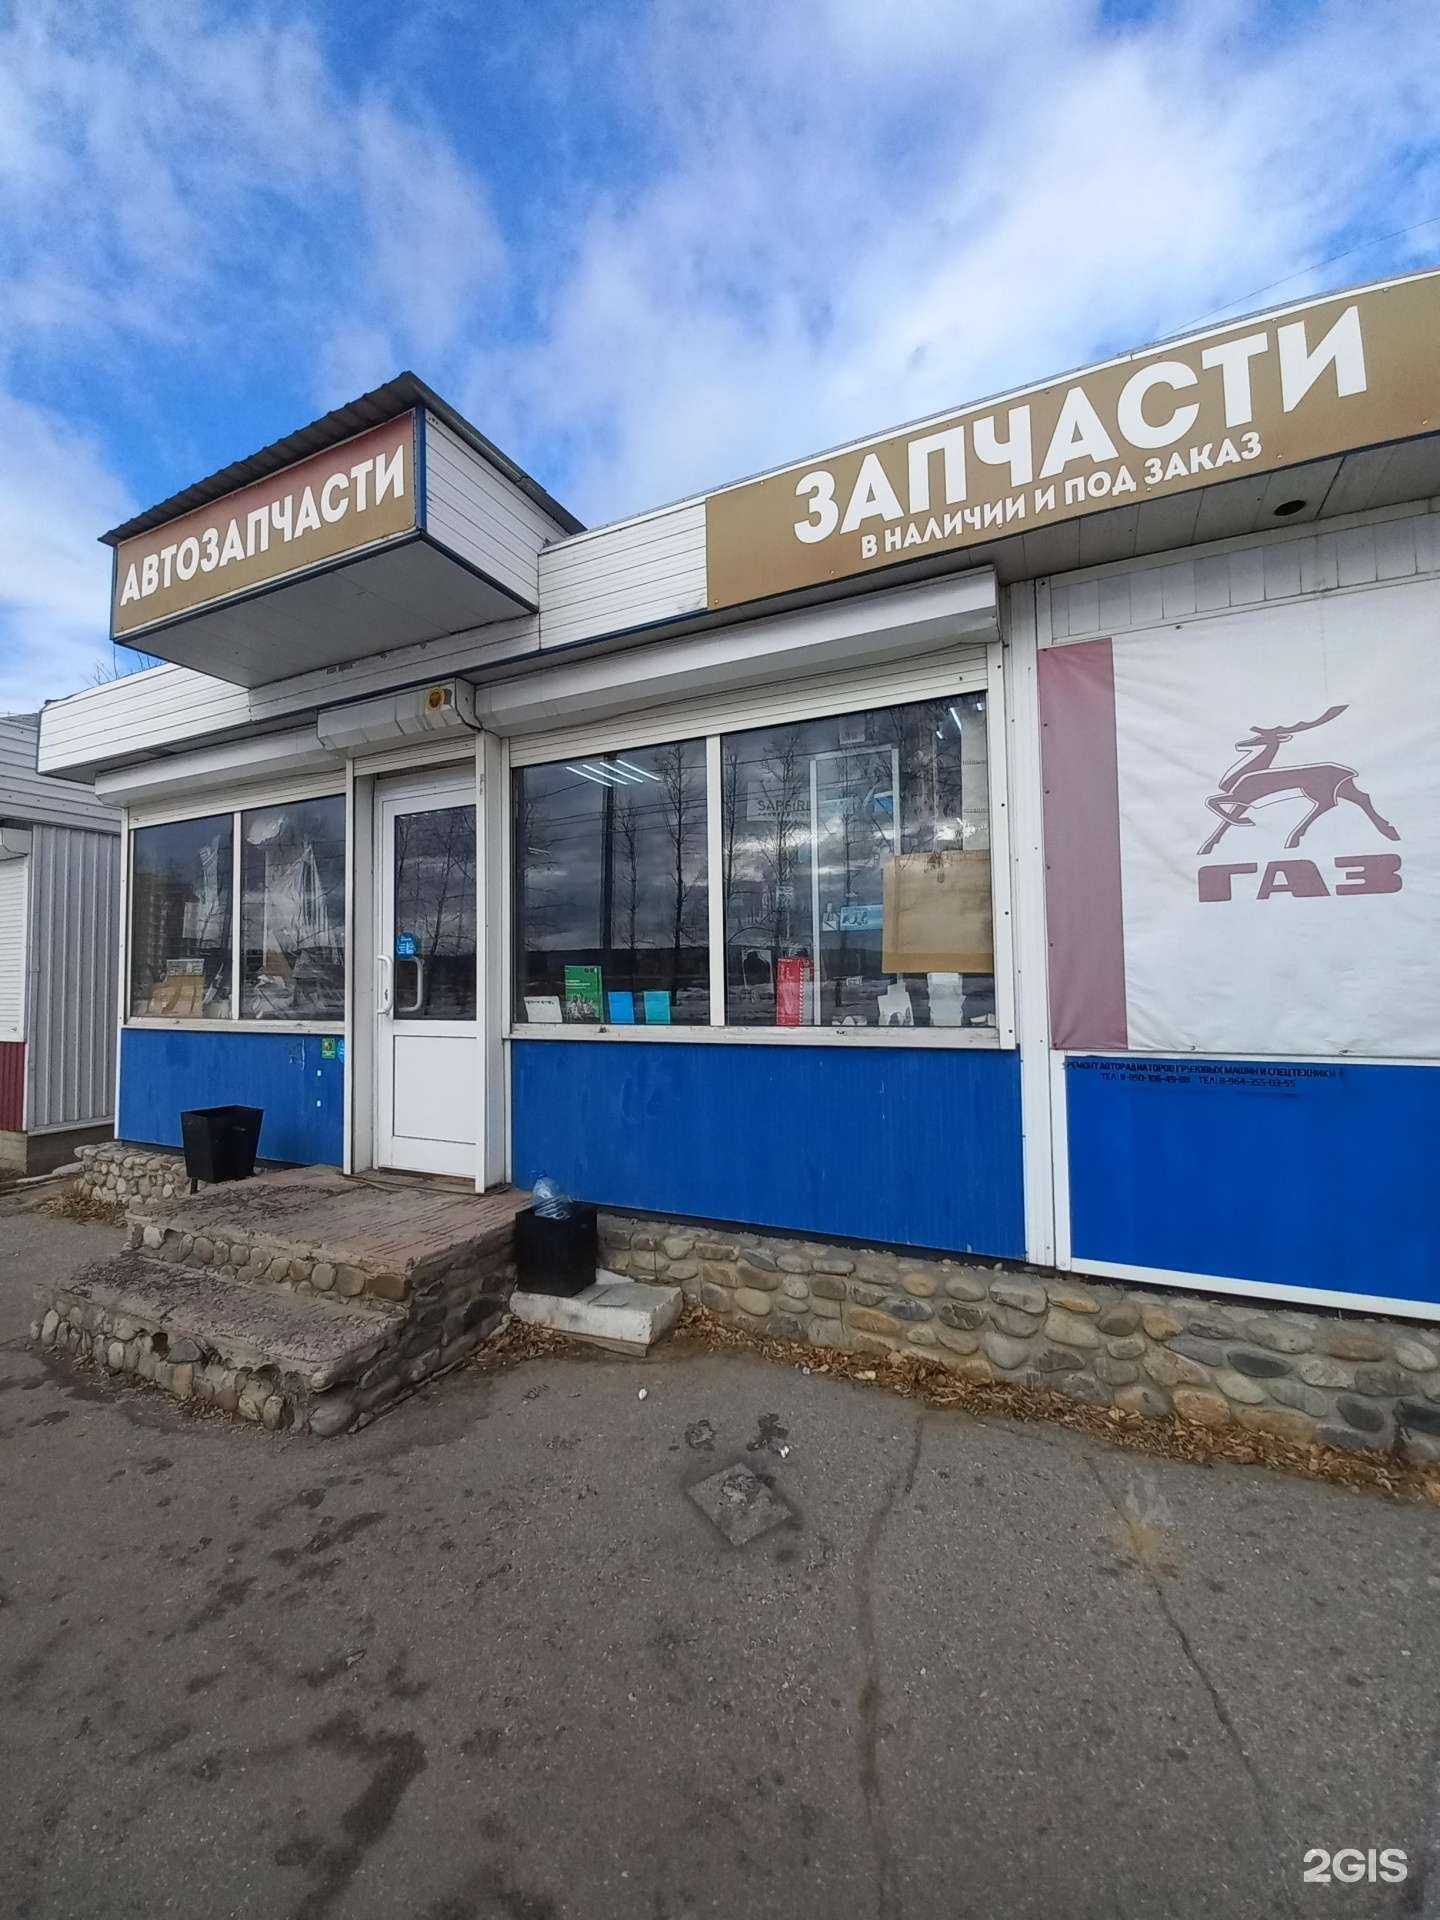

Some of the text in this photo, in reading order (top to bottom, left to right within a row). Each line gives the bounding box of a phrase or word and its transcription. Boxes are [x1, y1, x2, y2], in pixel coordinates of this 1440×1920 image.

[794, 305, 1368, 544] ЗАПЧАСТИ
[861, 431, 1263, 560] В НАЛИЧИИ И ПОД ЗАКАЗ
[120, 444, 405, 607] АВТОЗАПЧАСТИ
[1198, 853, 1403, 903] ГАЗ
